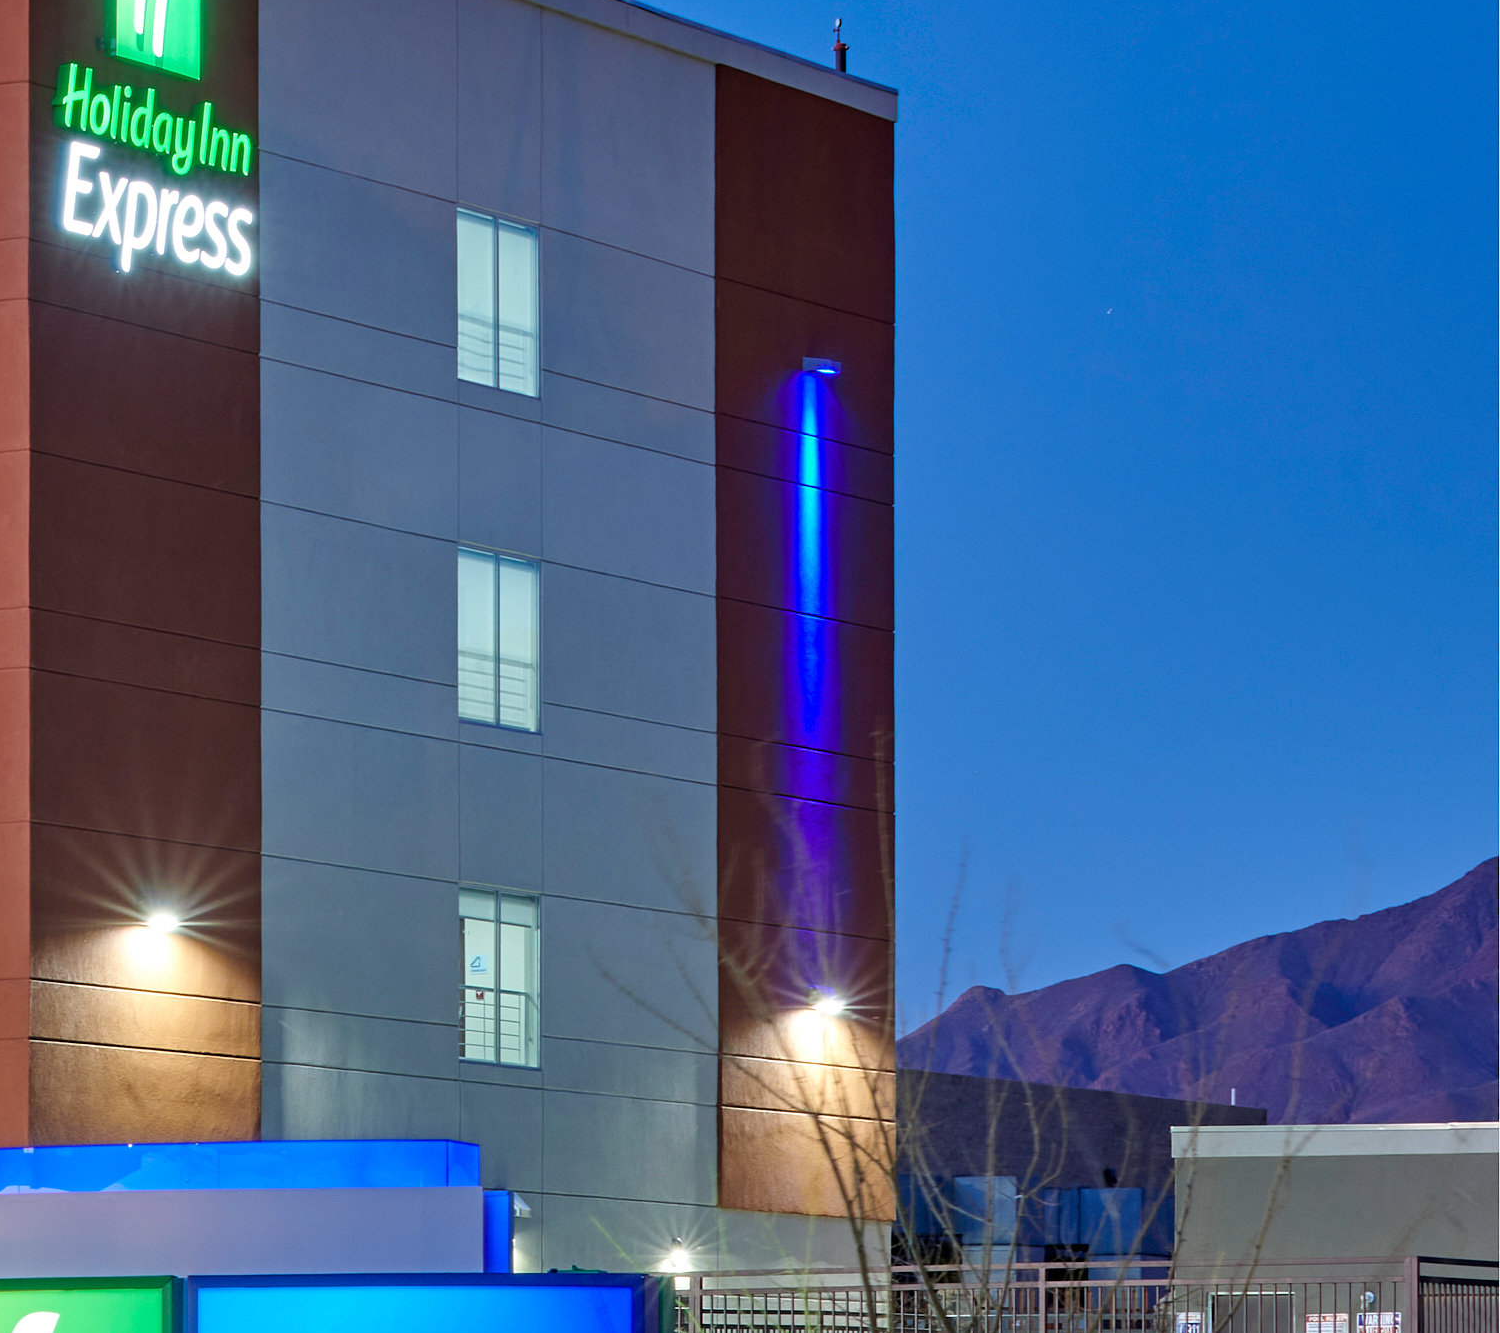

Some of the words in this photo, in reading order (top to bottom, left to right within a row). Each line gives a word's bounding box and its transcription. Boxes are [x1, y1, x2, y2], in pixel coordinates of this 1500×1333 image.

[62, 63, 195, 175] Holiday
[200, 102, 250, 175] Inn
[62, 141, 253, 276] Express
